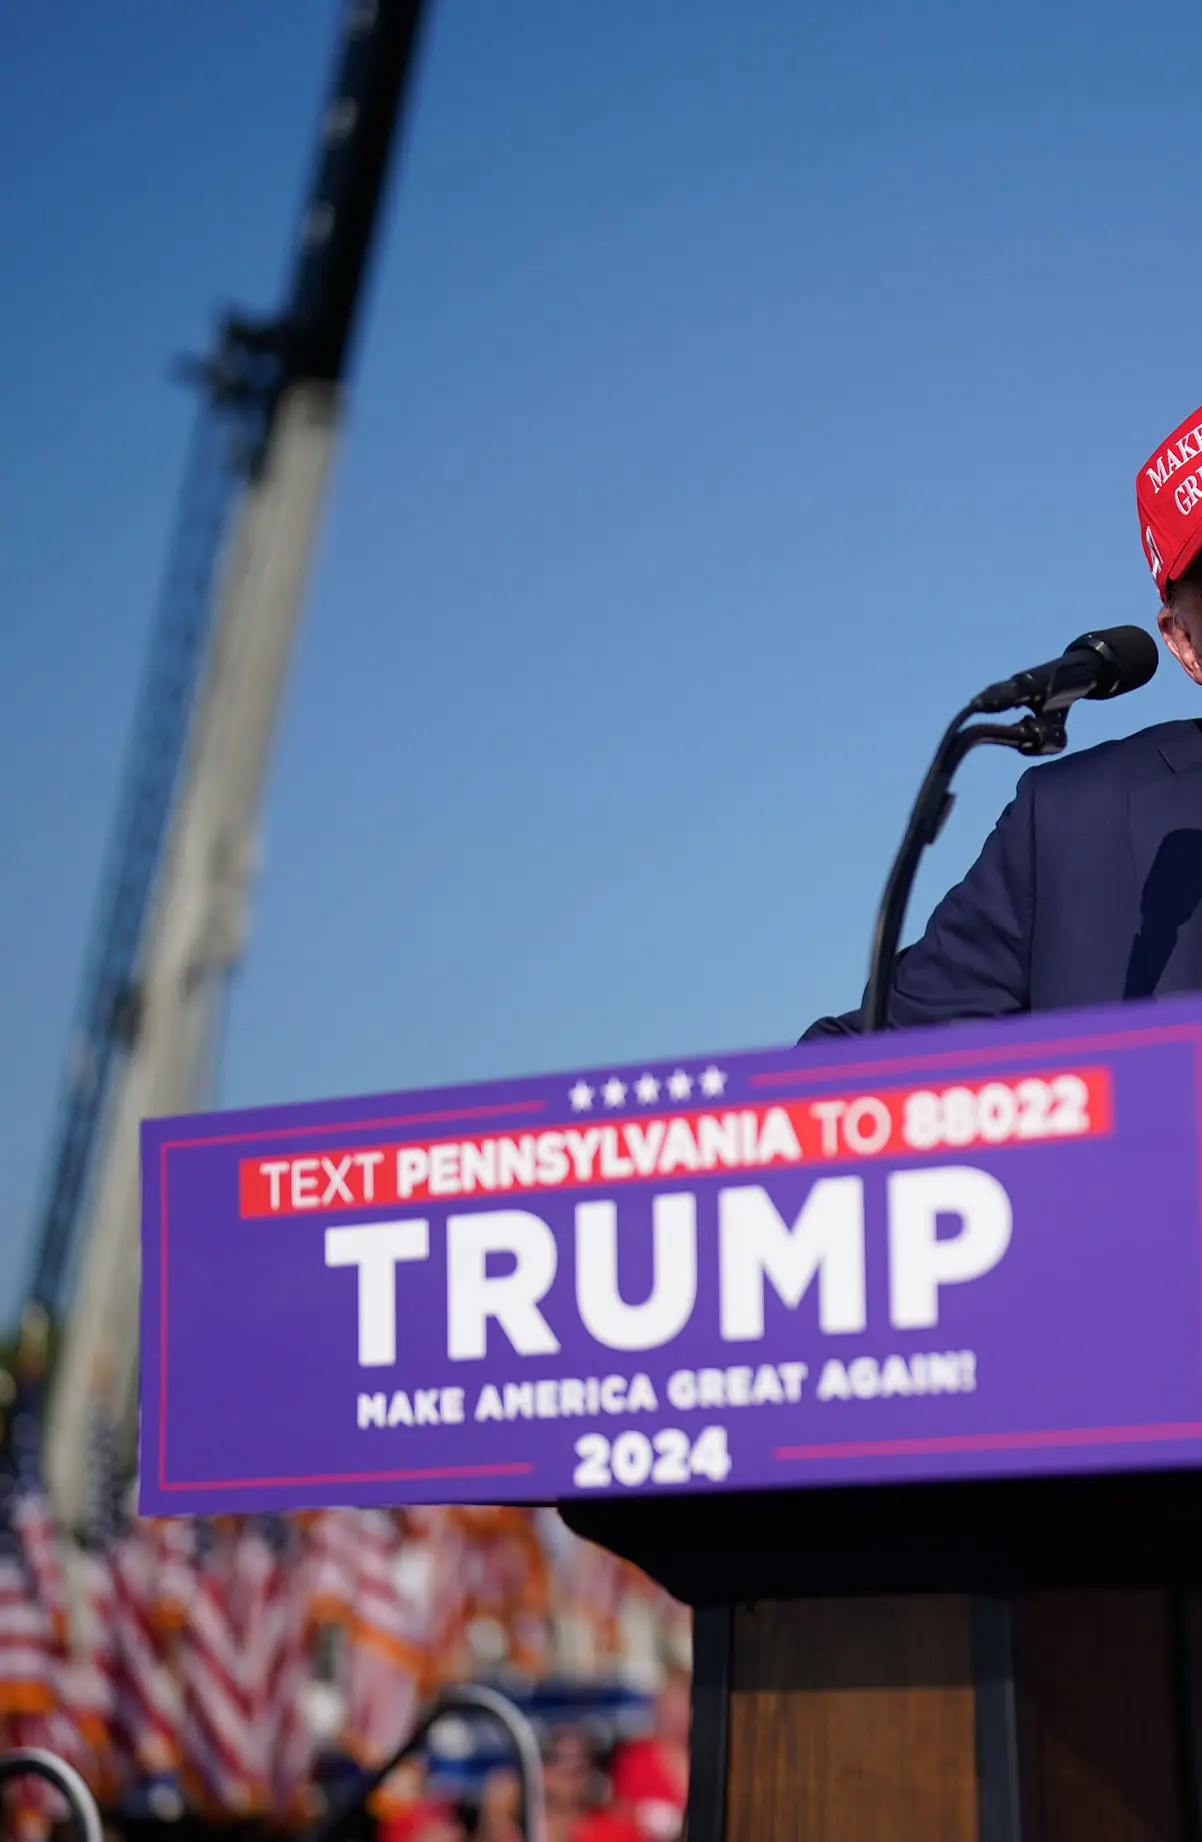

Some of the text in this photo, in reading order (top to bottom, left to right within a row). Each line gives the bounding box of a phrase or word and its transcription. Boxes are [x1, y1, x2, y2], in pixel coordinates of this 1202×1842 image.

[258, 1074, 1090, 1211] TEXT PENNSYLVANIA TO 88022
[324, 1165, 1014, 1368] TRUMP
[356, 1350, 977, 1429] MAKE AMERICA GREAT AGAIN!
[573, 1426, 731, 1489] 2024
